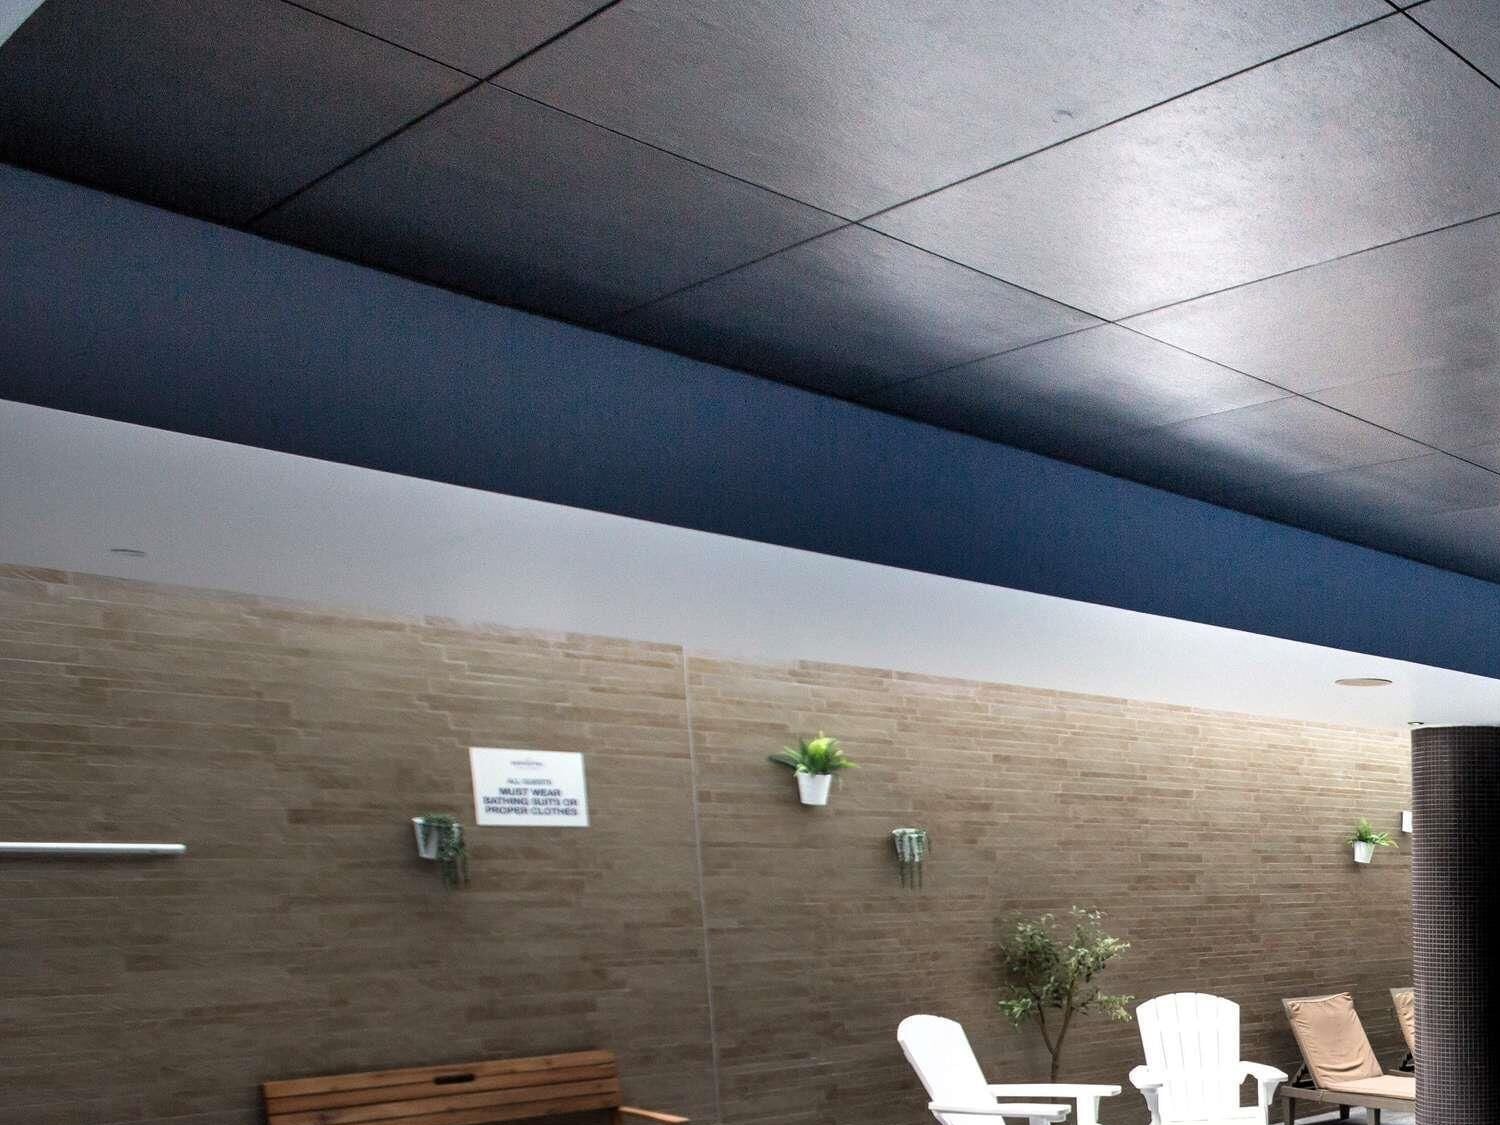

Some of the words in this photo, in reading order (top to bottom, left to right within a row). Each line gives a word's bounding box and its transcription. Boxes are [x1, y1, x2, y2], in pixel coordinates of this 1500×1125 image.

[499, 788, 528, 796] MUST
[531, 788, 561, 796] WEAR
[483, 796, 528, 805] BATHING
[531, 797, 561, 806] SUITS
[563, 798, 578, 806] OR
[485, 806, 528, 815] PROPER
[530, 807, 578, 816] CLOTHES
